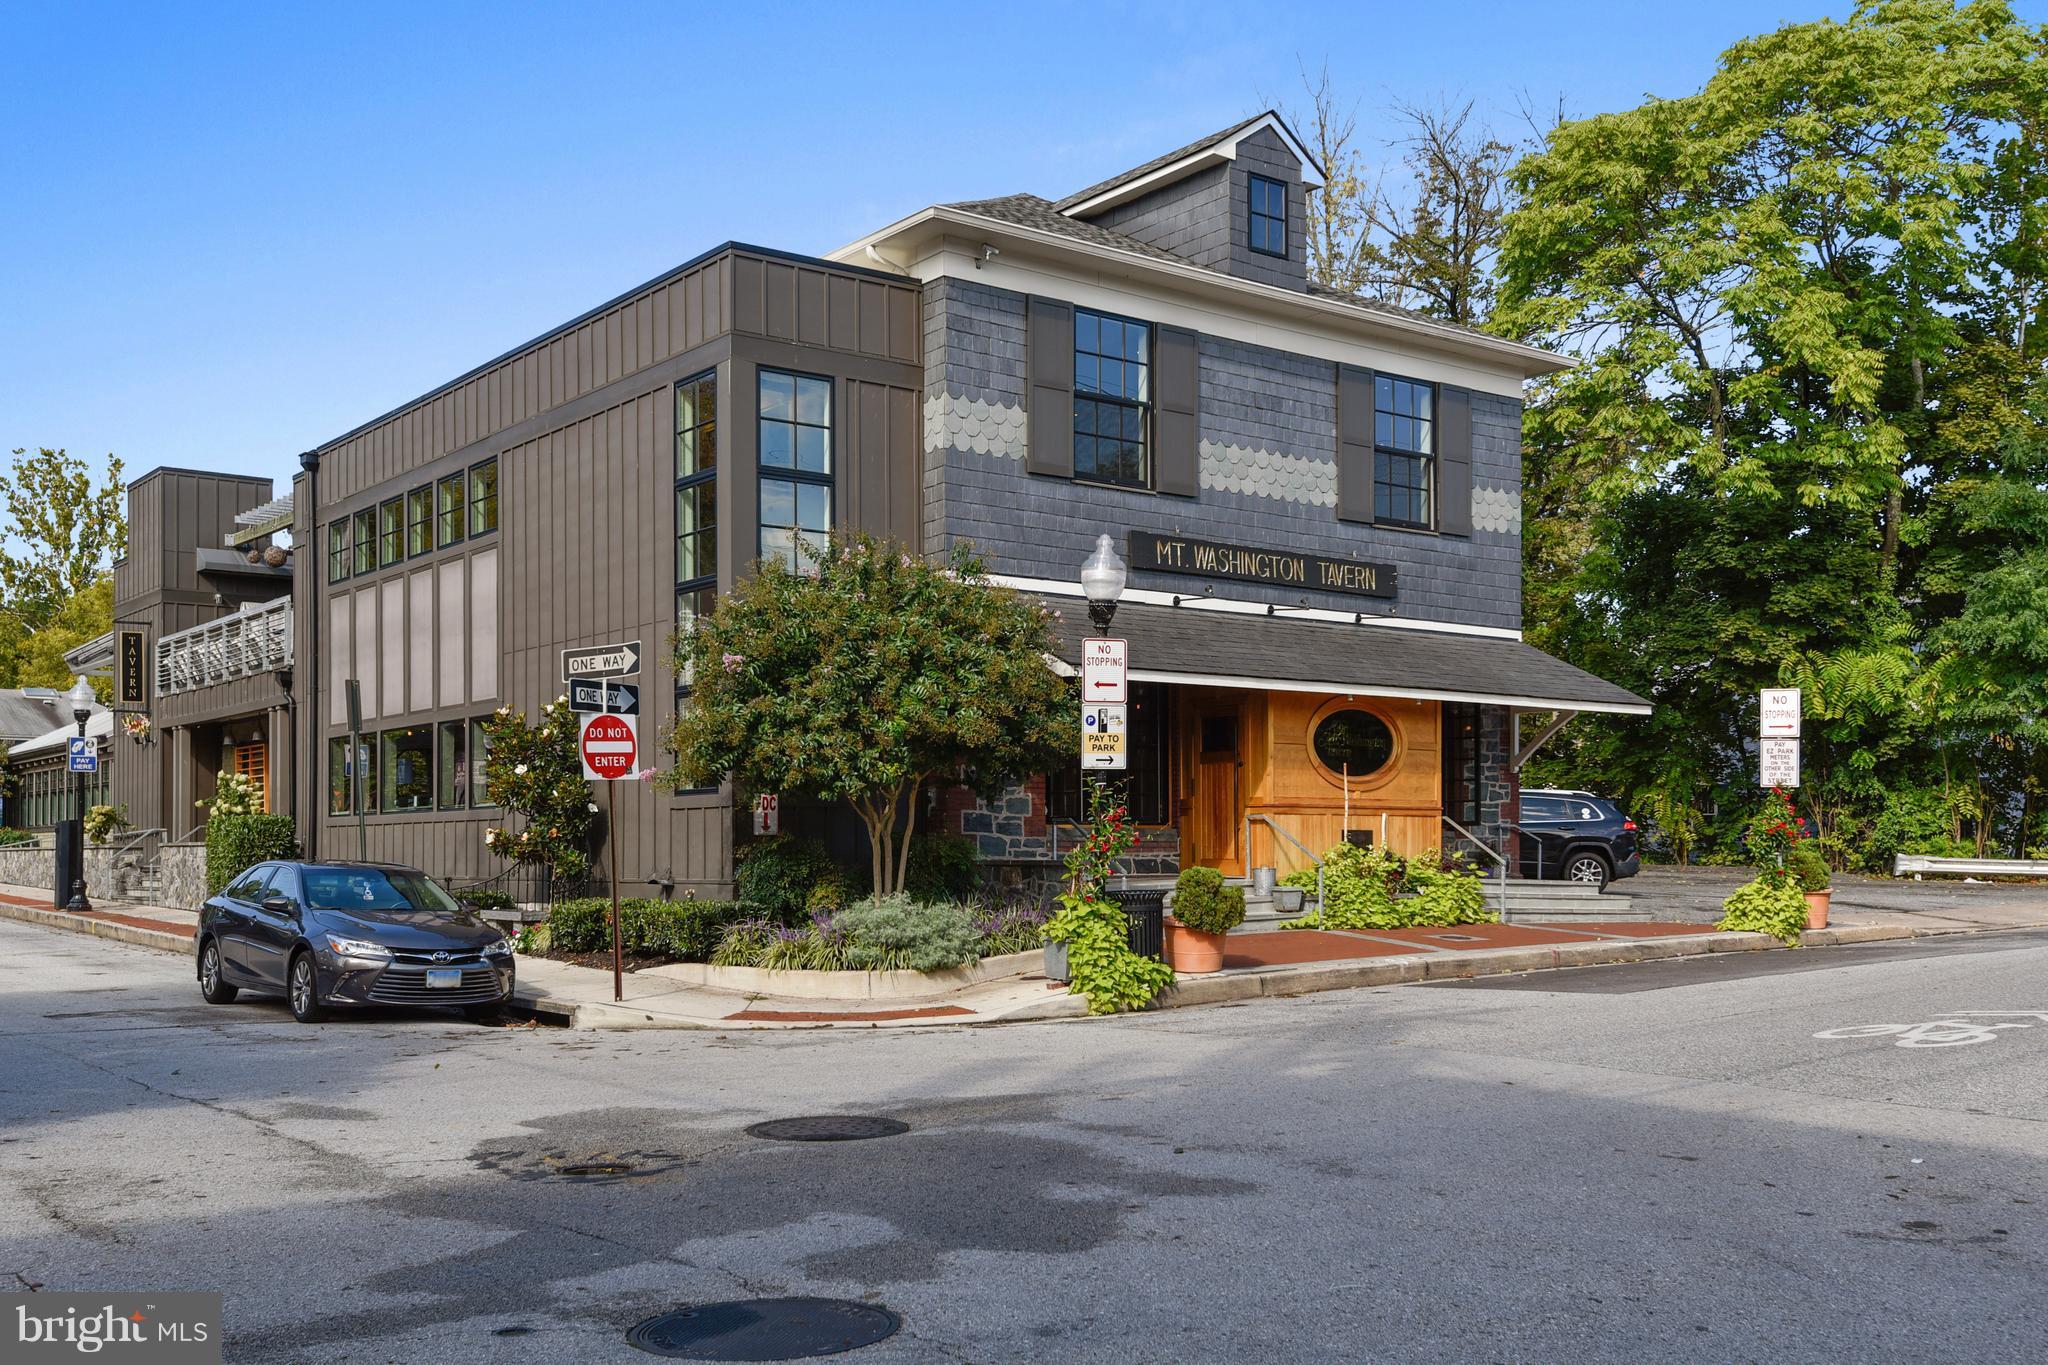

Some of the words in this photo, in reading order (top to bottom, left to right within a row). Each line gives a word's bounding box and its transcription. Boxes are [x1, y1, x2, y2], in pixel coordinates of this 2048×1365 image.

[1156, 539, 1189, 568] MT.
[1194, 545, 1304, 582] WASHINGTON
[1317, 561, 1376, 590] TAVERN
[1098, 645, 1111, 654] NO
[128, 636, 137, 697] TAVERN
[571, 658, 596, 671] ONE
[602, 654, 626, 668] WAY
[1086, 657, 1123, 666] STOPPING
[579, 689, 597, 702] ONE
[600, 692, 619, 705] AY
[1772, 695, 1788, 705] NO
[1764, 709, 1796, 719] STOPPING
[589, 727, 604, 738] DO
[607, 727, 627, 738] NOT
[1088, 734, 1105, 743] PAY
[1107, 734, 1120, 743] TO
[1092, 744, 1116, 752] PARK
[595, 756, 626, 767] ENTER
[756, 796, 776, 811] DC
